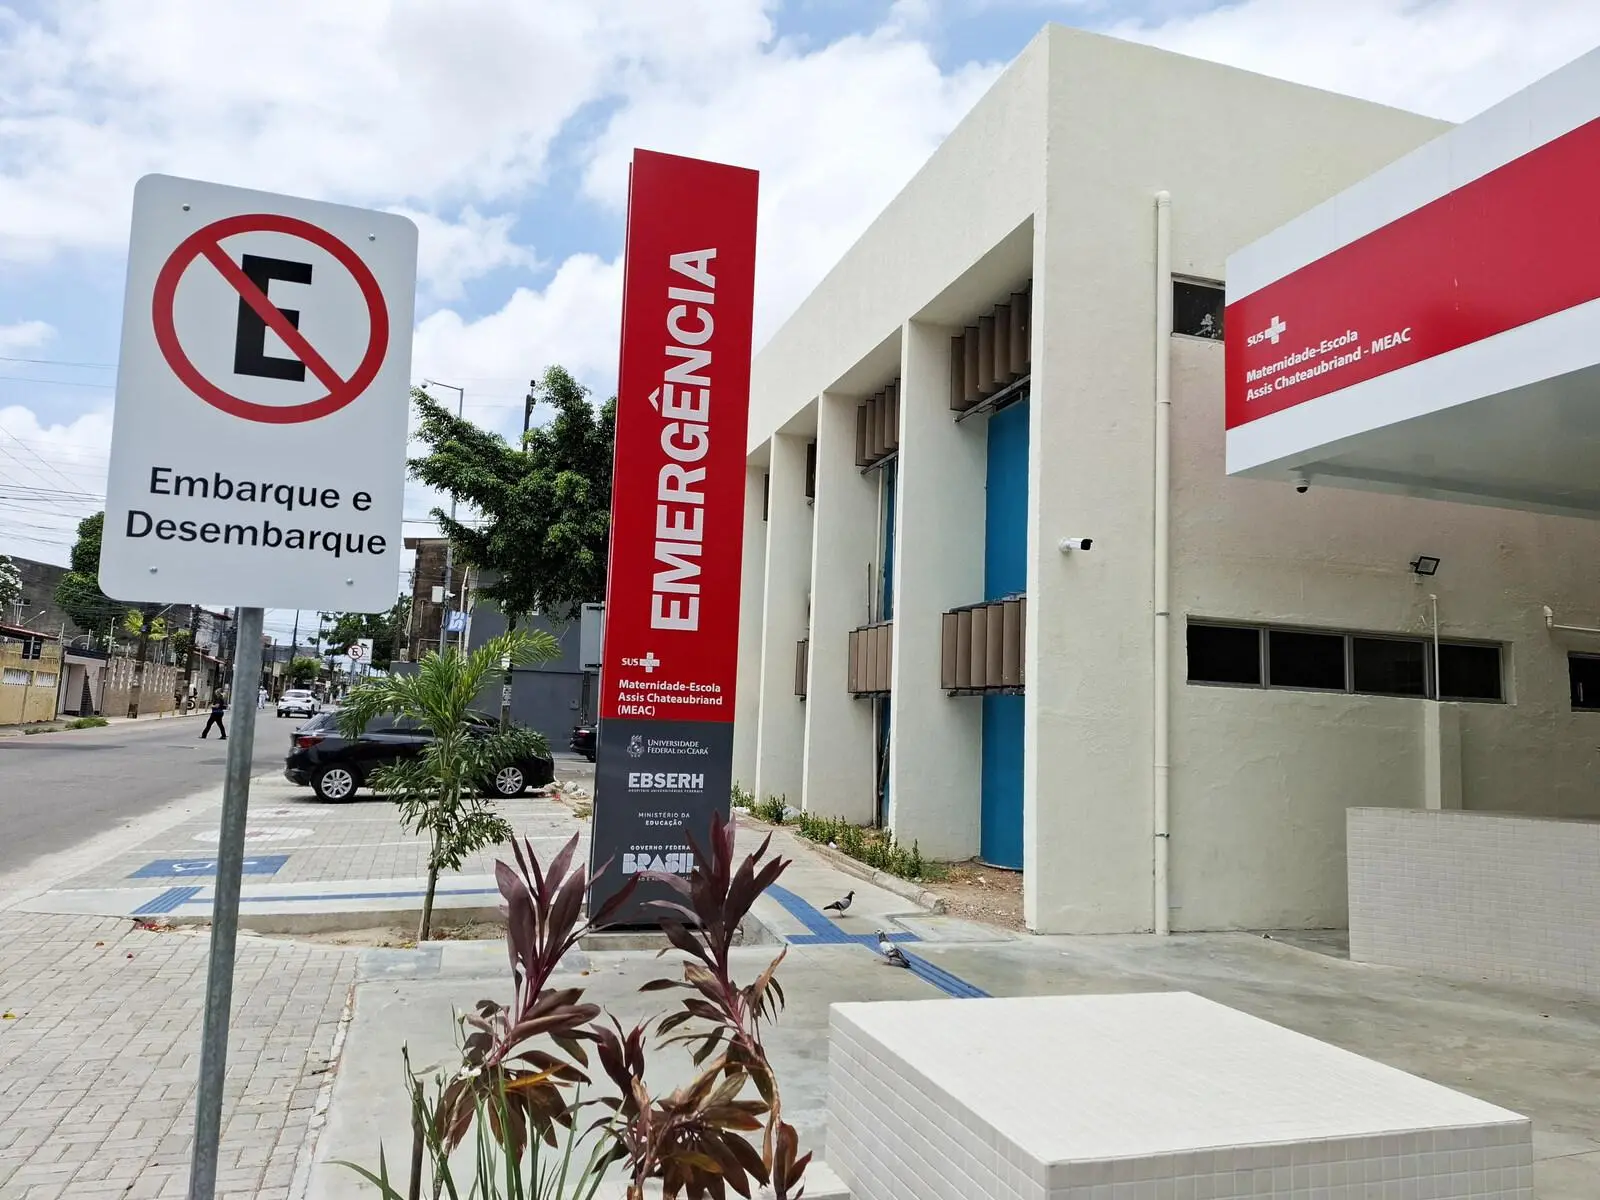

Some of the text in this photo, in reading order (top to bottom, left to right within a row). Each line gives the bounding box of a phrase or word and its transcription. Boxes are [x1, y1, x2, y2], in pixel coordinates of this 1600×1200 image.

[234, 253, 313, 383] E
[1247, 331, 1264, 347] SUS
[1246, 330, 1358, 383] Maternidade-Escola
[1246, 382, 1273, 402] Assis
[1274, 346, 1362, 390] Chateaubriand
[1371, 327, 1412, 354] MEAC
[647, 247, 718, 631] EMERGÊNCIA
[149, 466, 373, 512] Embarque e
[126, 509, 388, 558] Desembarque
[621, 657, 639, 666] SUS
[618, 679, 721, 692] Maternidade-Escola
[617, 692, 723, 705] Assis Chateaubriand
[617, 704, 655, 716] (MEAC)
[687, 747, 709, 755] CEARÁ
[628, 772, 704, 788] EBSERH
